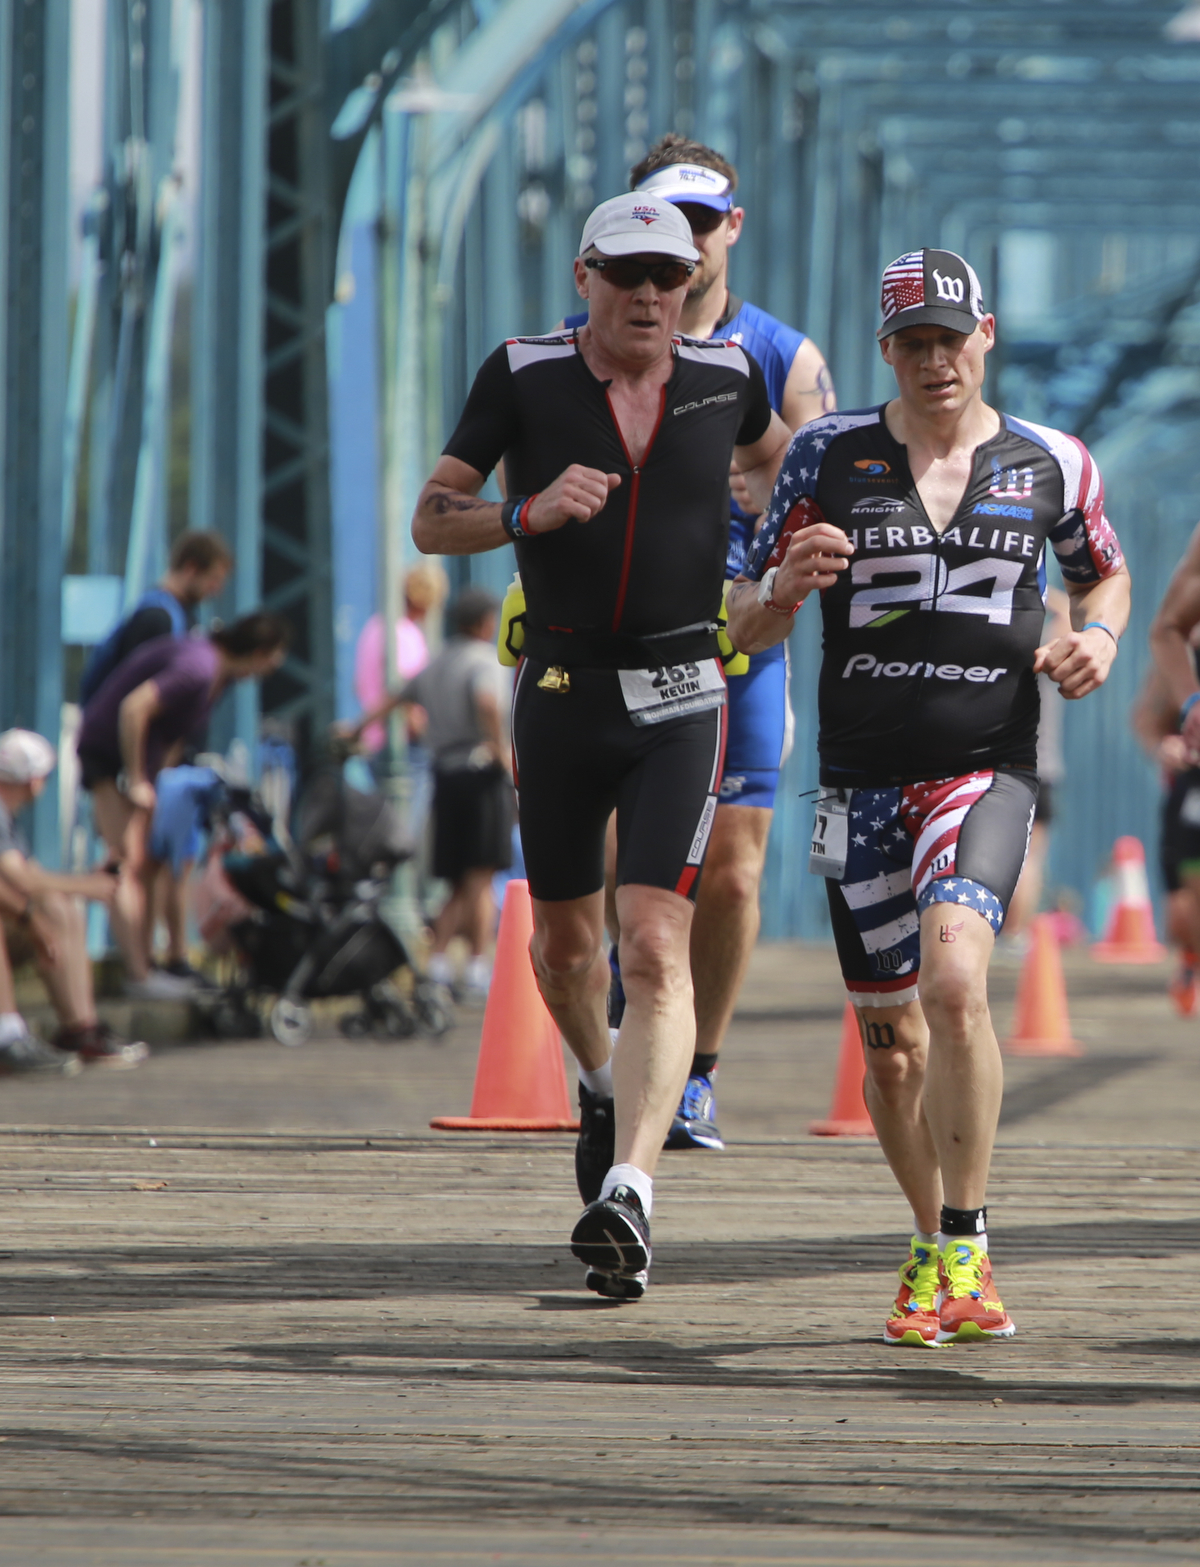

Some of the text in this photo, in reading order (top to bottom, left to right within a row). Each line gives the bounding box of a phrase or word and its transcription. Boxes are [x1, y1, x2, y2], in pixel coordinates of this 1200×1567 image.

[633, 205, 657, 213] USA
[673, 391, 738, 416] COURSE
[972, 502, 1034, 516] HOKA ONE
[1015, 513, 1033, 521] ONE
[849, 525, 1036, 556] HERBALIFE
[849, 553, 1024, 628] 24
[842, 653, 1008, 682] Pioneer
[659, 680, 701, 700] KEVIN
[643, 694, 723, 720] IRONMAN FOUNDATION
